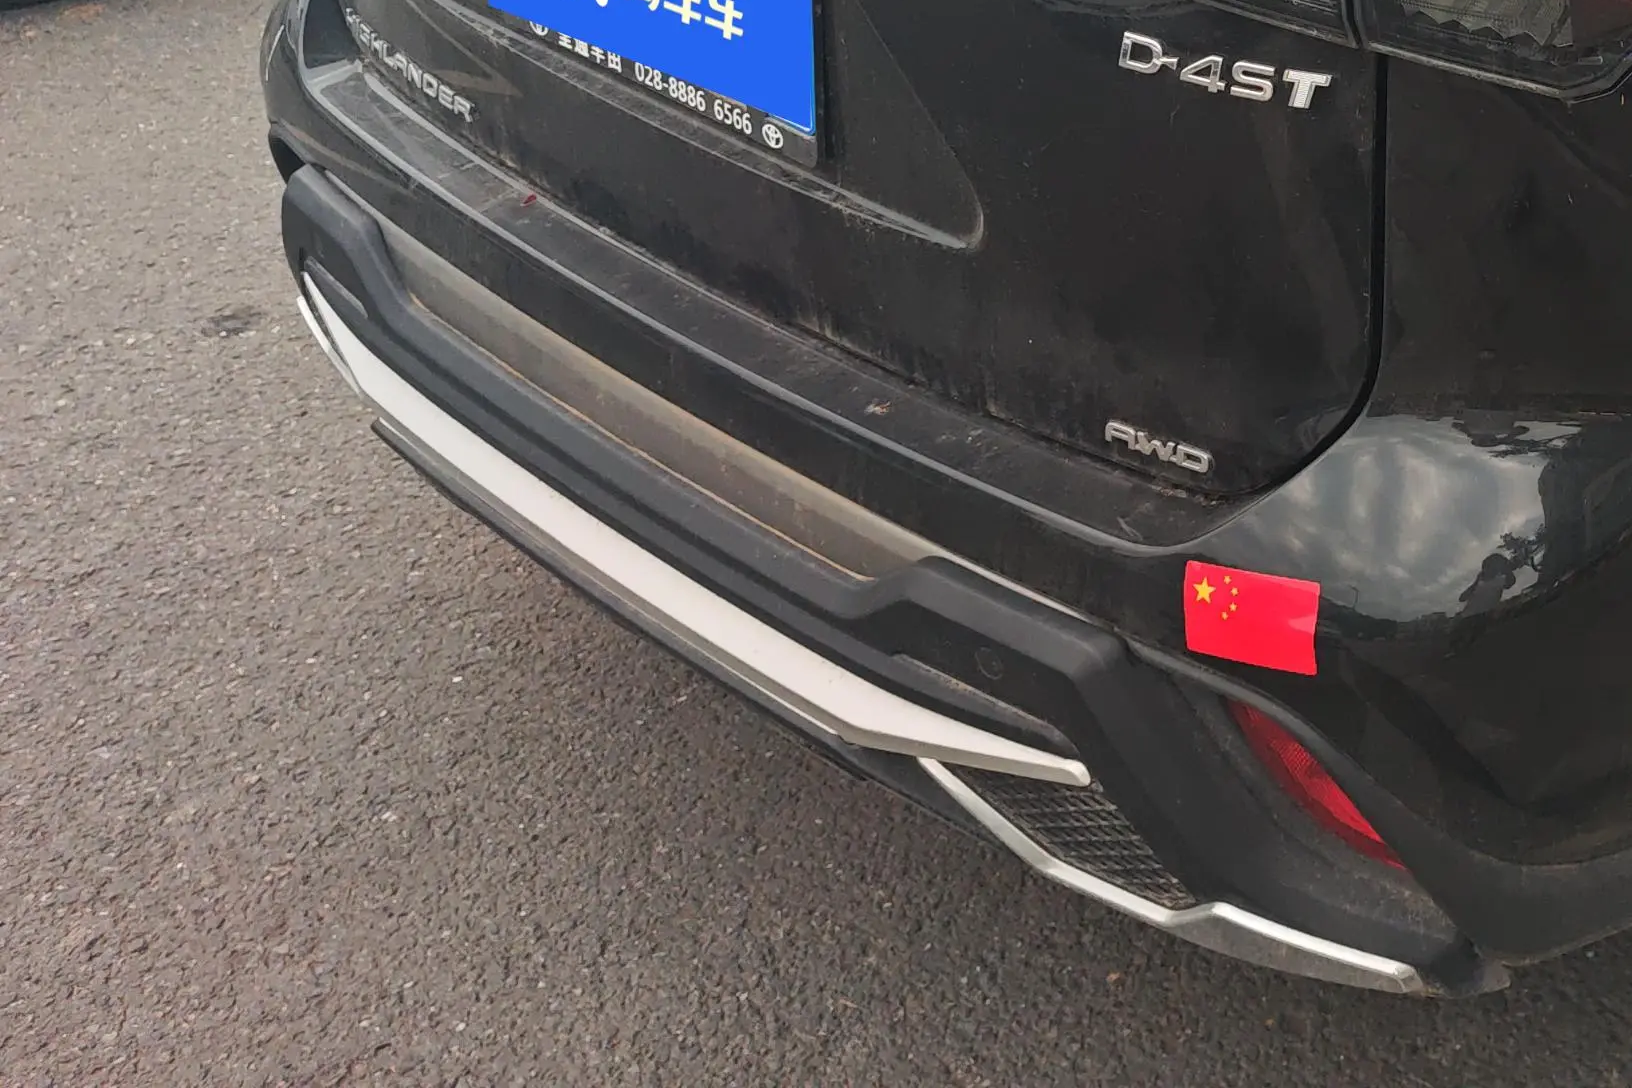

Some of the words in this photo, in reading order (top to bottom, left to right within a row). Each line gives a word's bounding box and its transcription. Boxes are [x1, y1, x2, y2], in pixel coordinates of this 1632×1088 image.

[634, 61, 707, 113] 028-8886
[713, 98, 753, 136] 6566
[1104, 421, 1212, 474] AWD
